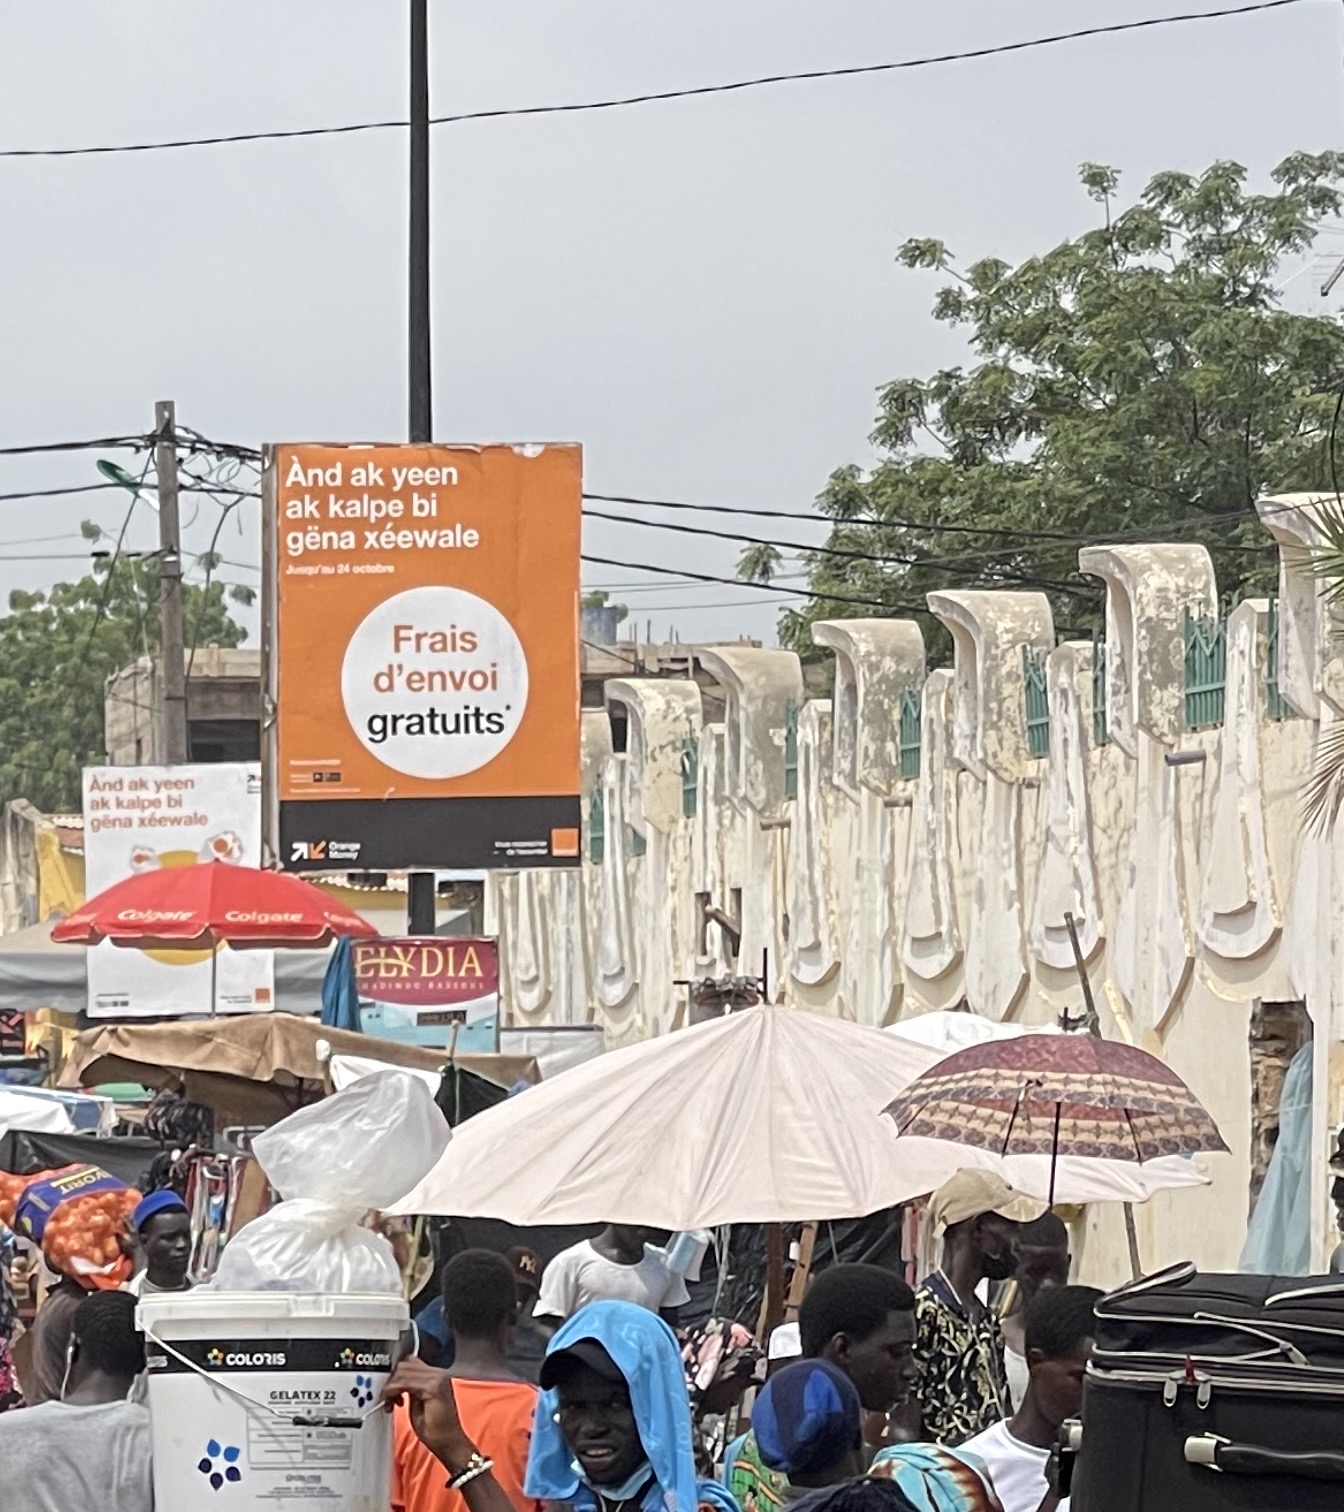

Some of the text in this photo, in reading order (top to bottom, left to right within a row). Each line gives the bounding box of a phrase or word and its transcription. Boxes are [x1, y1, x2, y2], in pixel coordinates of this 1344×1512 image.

[285, 456, 458, 491] Ànd ak yeen
[286, 493, 437, 523] ak kalpe bi
[286, 523, 479, 556] gëna xéewale
[393, 624, 478, 654] Frais
[373, 662, 498, 692] d'envoi
[89, 774, 194, 793] Ànd ak yeen
[90, 794, 183, 811] ak kalpe bi
[90, 812, 208, 832] gëna xéewale
[117, 908, 198, 923] Colgate
[224, 910, 304, 924] Colgate
[226, 1352, 286, 1367] COLORIS
[270, 1390, 337, 1401] GELATEX 22
